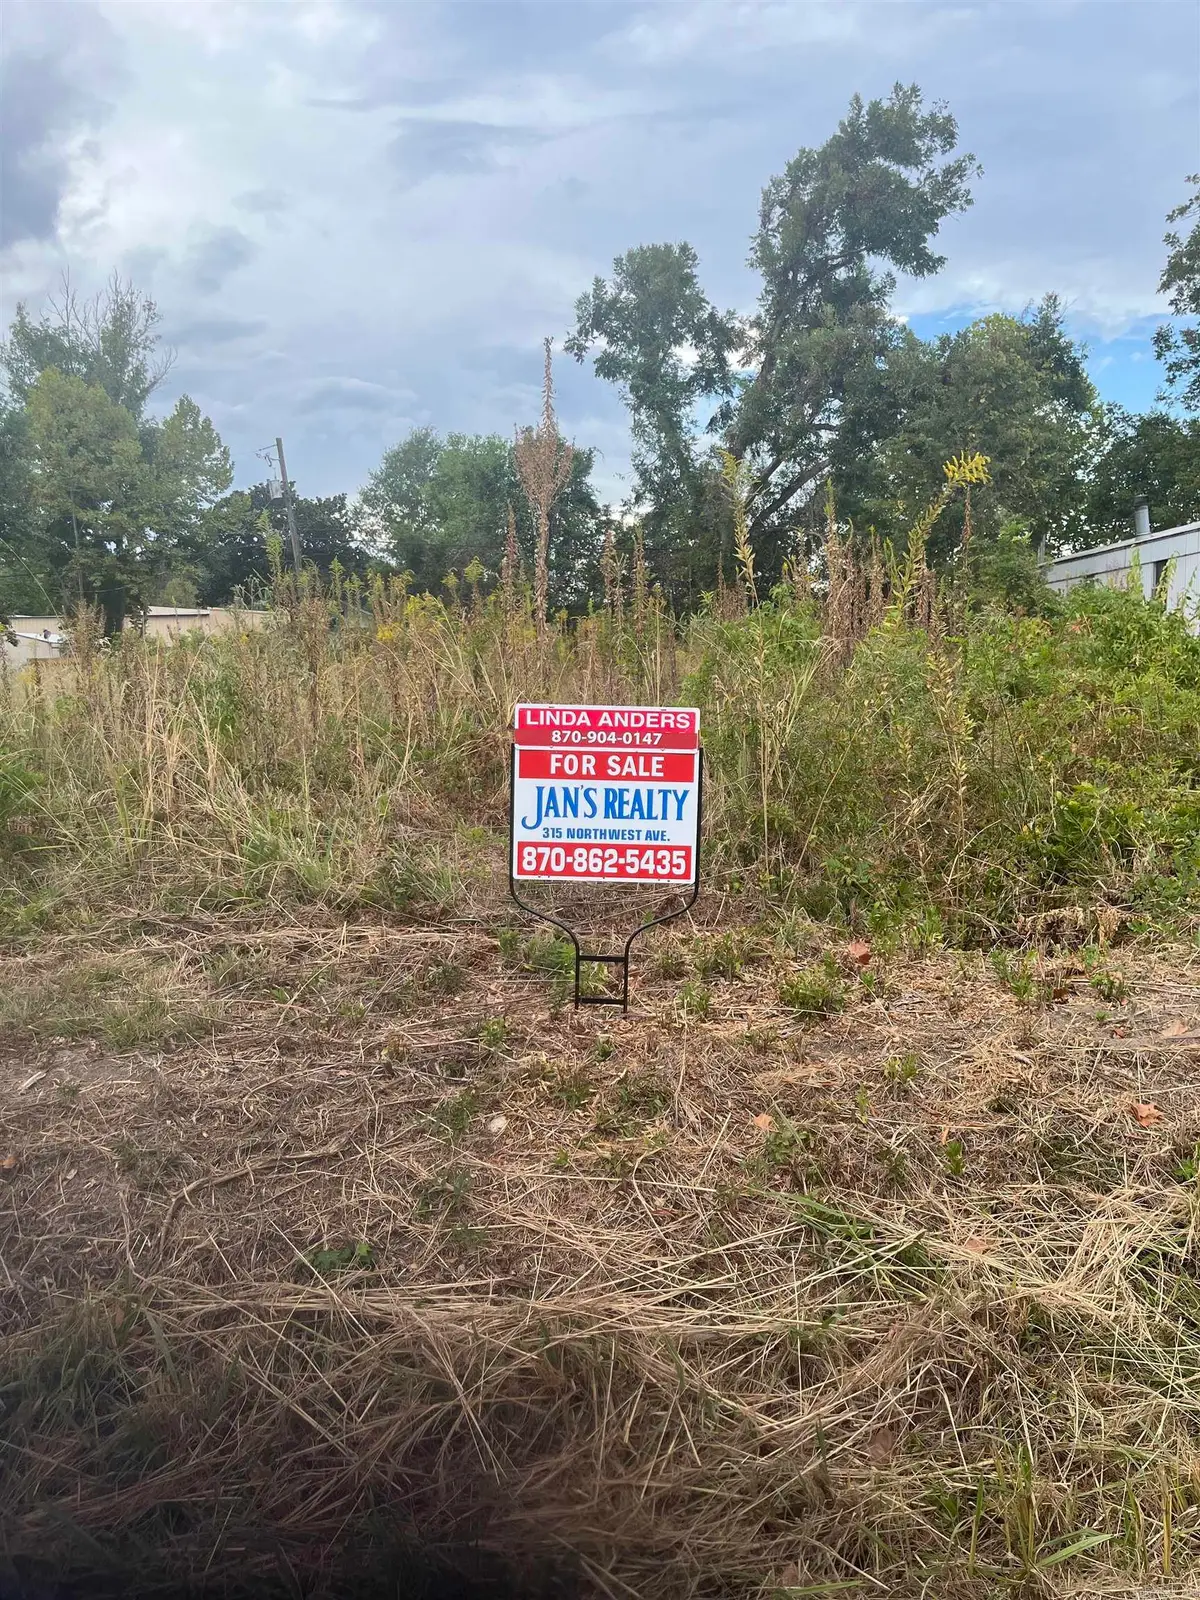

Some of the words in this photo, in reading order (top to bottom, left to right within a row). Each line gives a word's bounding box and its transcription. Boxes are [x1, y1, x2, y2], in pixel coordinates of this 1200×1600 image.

[526, 710, 591, 727] LINDA
[598, 711, 690, 728] ANDERS
[551, 730, 662, 745] 870-904-0147
[550, 753, 596, 776] FOR
[607, 755, 664, 777] SALE
[521, 785, 598, 830] JAN'S
[603, 787, 690, 821] REALTY
[542, 827, 563, 839] 315
[566, 828, 642, 841] NORTHWEST
[645, 830, 671, 842] AVE.
[522, 846, 686, 875] 870-862-5435
